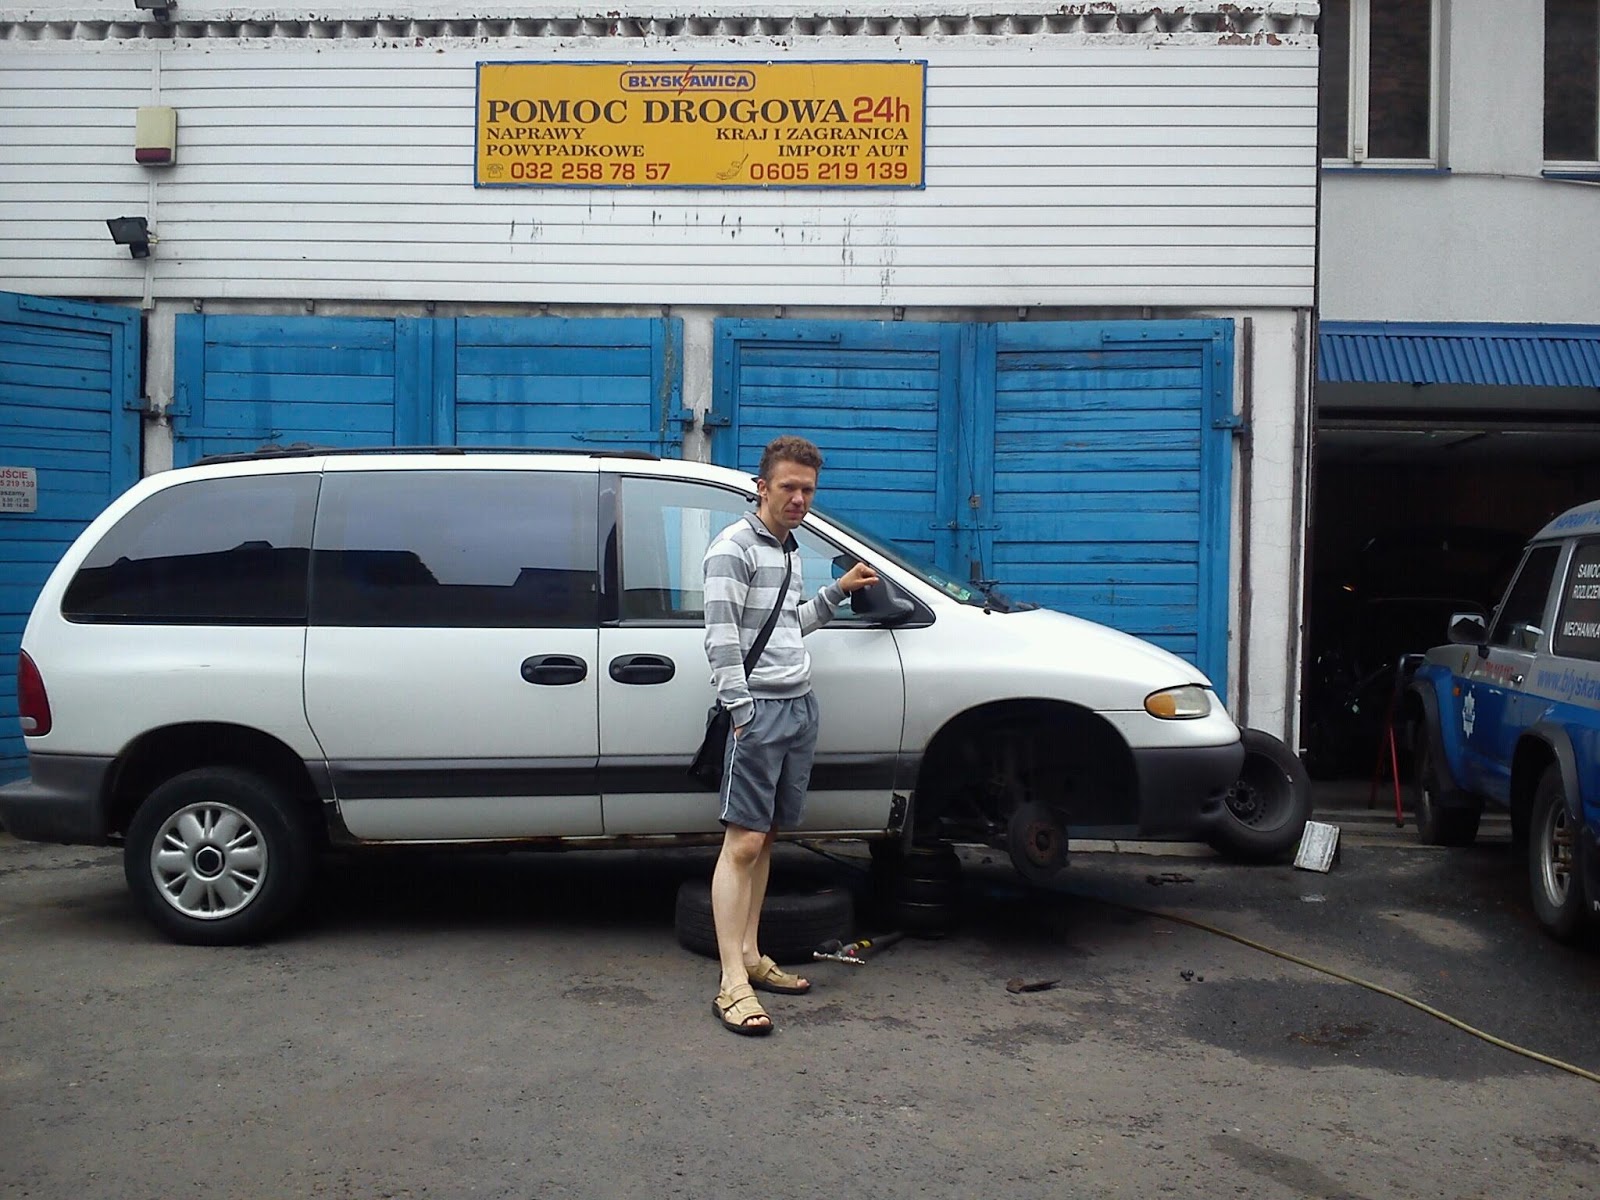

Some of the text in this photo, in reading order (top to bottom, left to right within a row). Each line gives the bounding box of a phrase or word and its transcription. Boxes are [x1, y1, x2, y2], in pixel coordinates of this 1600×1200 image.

[487, 96, 911, 124] POMOC DROGOWA 24h
[486, 128, 586, 140] NAPRAWY
[716, 127, 909, 141] KRAJ I ZAGRANICA
[486, 145, 645, 157] POWYPADKOWE
[778, 145, 909, 158] IMPORT AUT
[510, 162, 670, 180] 032 258 78 57
[750, 163, 908, 180] 0605 219 139
